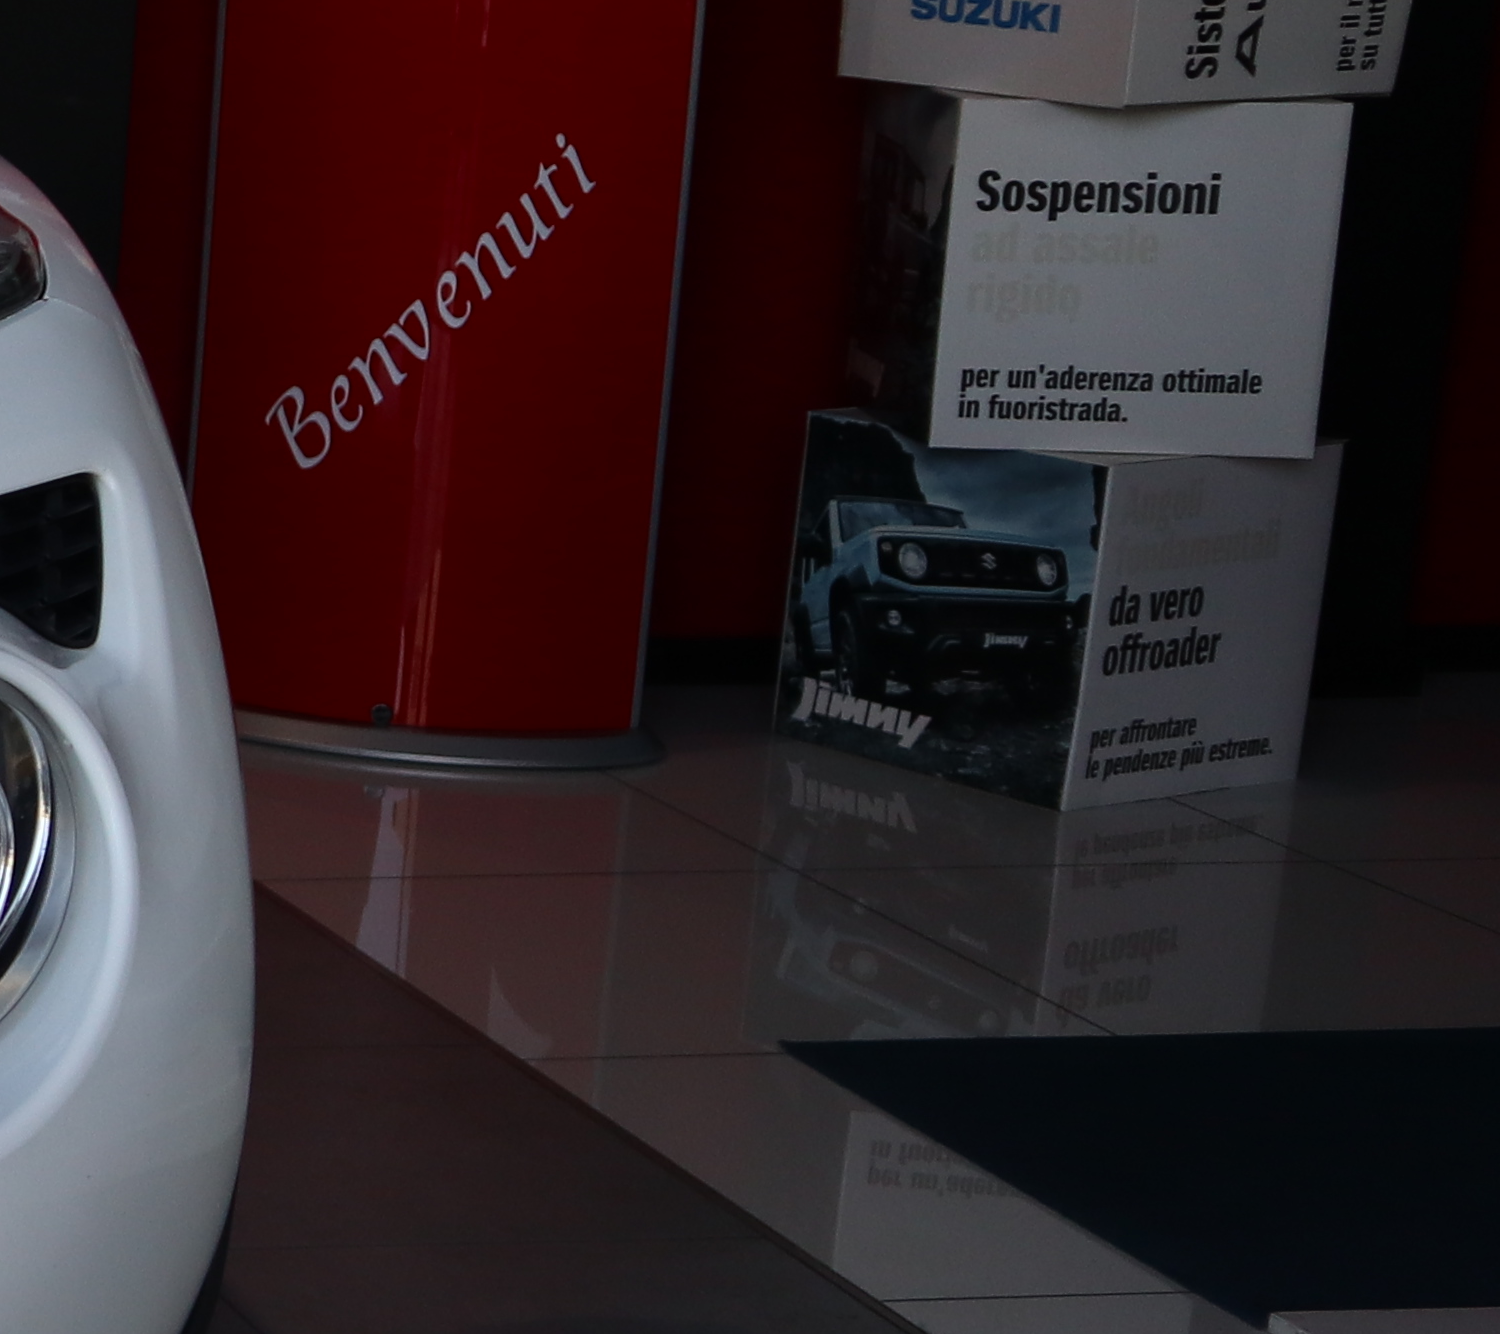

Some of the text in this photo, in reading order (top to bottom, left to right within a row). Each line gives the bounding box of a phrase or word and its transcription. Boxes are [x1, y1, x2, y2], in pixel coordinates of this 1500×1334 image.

[1340, 14, 1360, 30] il
[1337, 36, 1356, 72] per
[1361, 44, 1379, 71] su
[975, 170, 1221, 222] Sospensioni
[971, 221, 1159, 265] ad assale
[264, 132, 597, 470] Benvenuti
[960, 364, 1263, 395] per un'aderenza ottimale
[958, 393, 1128, 423] in fuoristrada.
[1108, 585, 1204, 627] da vero
[1102, 627, 1222, 676] offroader
[1089, 717, 1197, 753] per affrontare
[1085, 736, 1273, 781] le pendenze più estreme.
